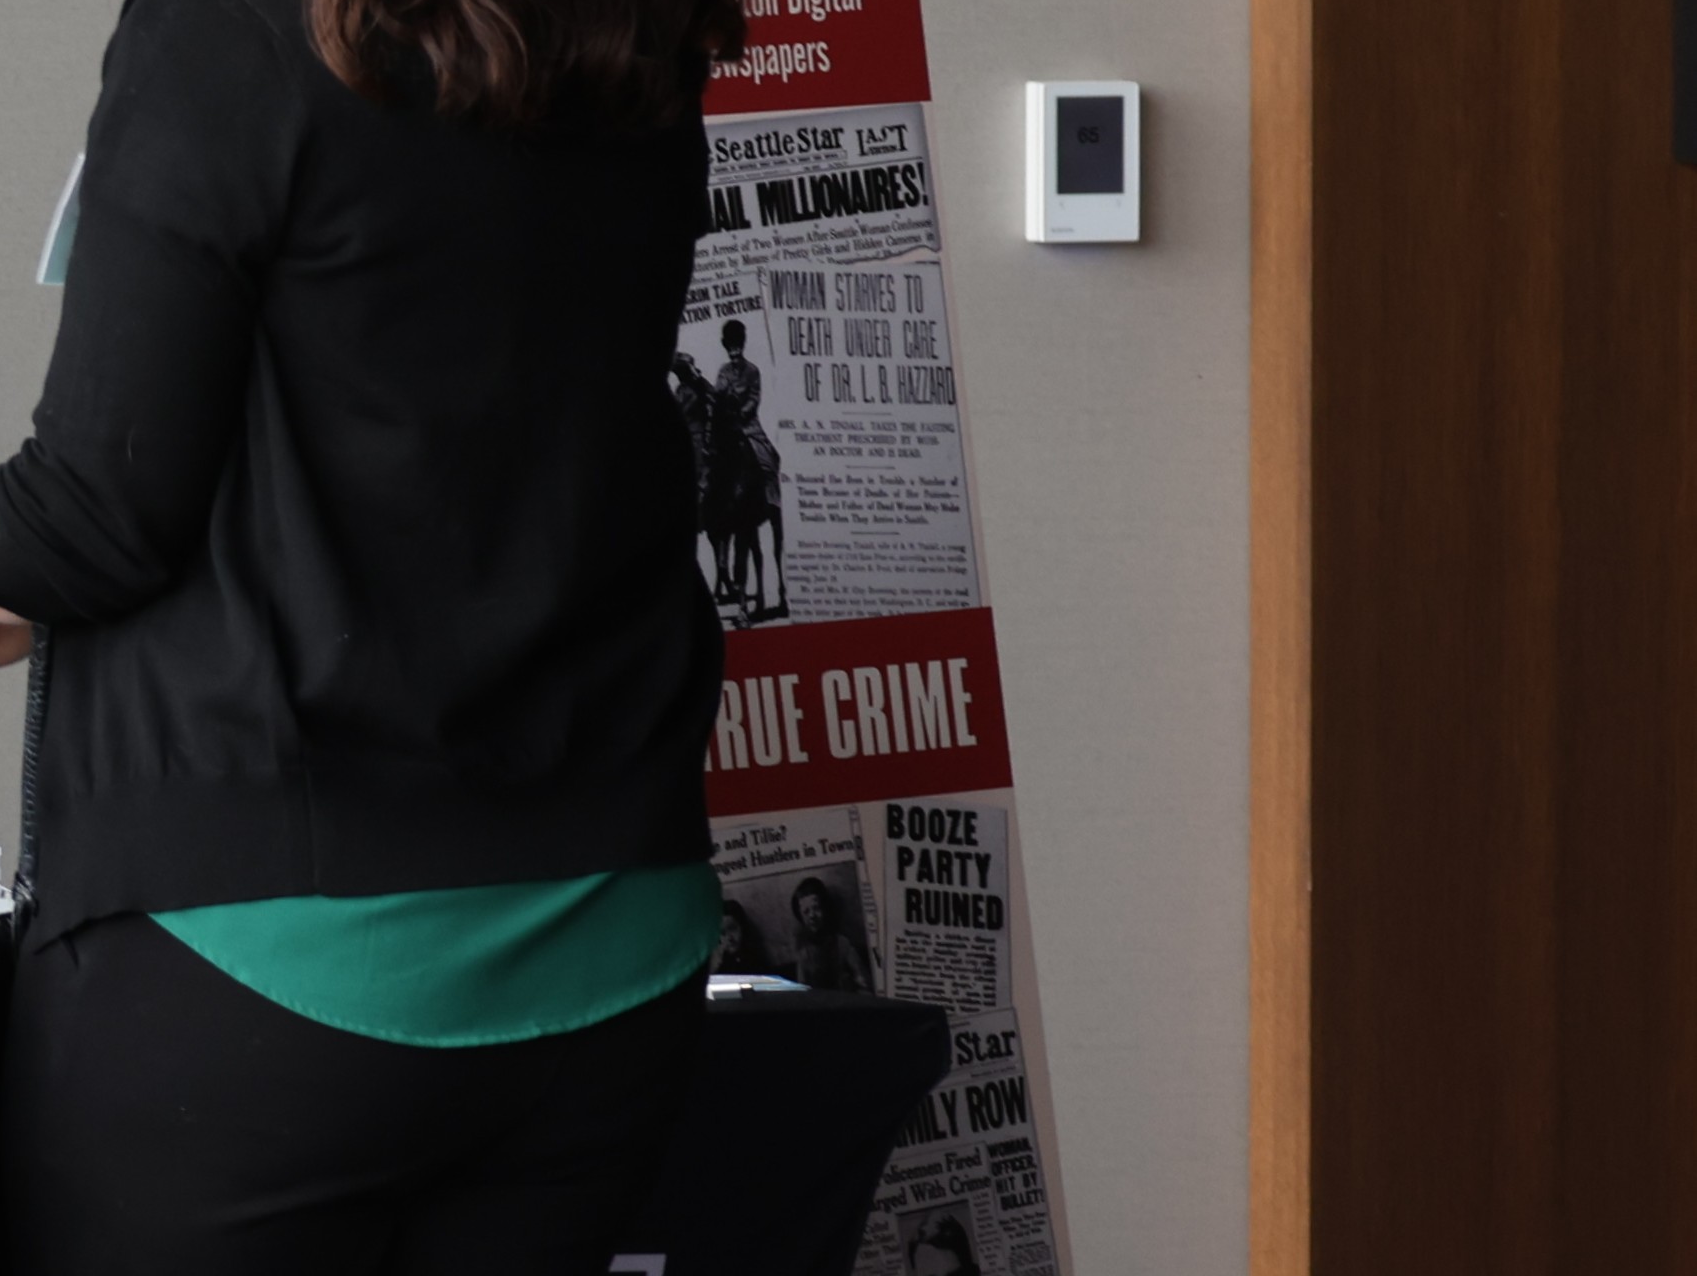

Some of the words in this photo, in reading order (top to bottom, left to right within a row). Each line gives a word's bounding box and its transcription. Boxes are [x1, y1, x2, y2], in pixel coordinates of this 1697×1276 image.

[710, 41, 831, 84] ewspapers
[715, 131, 795, 164] Seattle
[797, 127, 845, 154] Star
[1076, 126, 1100, 144] 65
[708, 185, 752, 234] AIL
[756, 162, 929, 227] MILLIONAIRES!
[712, 280, 741, 300] TALE
[714, 295, 764, 318] TORTURE
[770, 270, 826, 311] WOMAN
[835, 272, 897, 314] STARVES
[904, 274, 925, 314] TO
[788, 316, 834, 357] DEATH
[844, 318, 893, 359] UNDER
[903, 320, 940, 361] CARE
[803, 363, 823, 403] OF
[831, 364, 855, 404] DR.
[861, 364, 875, 404] L.
[877, 365, 893, 405] B.
[896, 365, 957, 406] HAZZARD
[705, 673, 809, 772] RUE
[821, 657, 978, 759] CRIME
[886, 803, 978, 846] BOOZE
[715, 857, 748, 876] ngest
[803, 842, 816, 858] in
[818, 838, 855, 855] Town
[896, 846, 992, 889] PARTY
[906, 888, 1003, 931] RUINED
[955, 1031, 1016, 1066] Star
[897, 1090, 957, 1148] MILY
[965, 1076, 1028, 1136] ROW
[884, 1163, 944, 1185] olicemen
[944, 1146, 983, 1173] Fired
[909, 1179, 947, 1203] With
[949, 1173, 992, 1196] Crime
